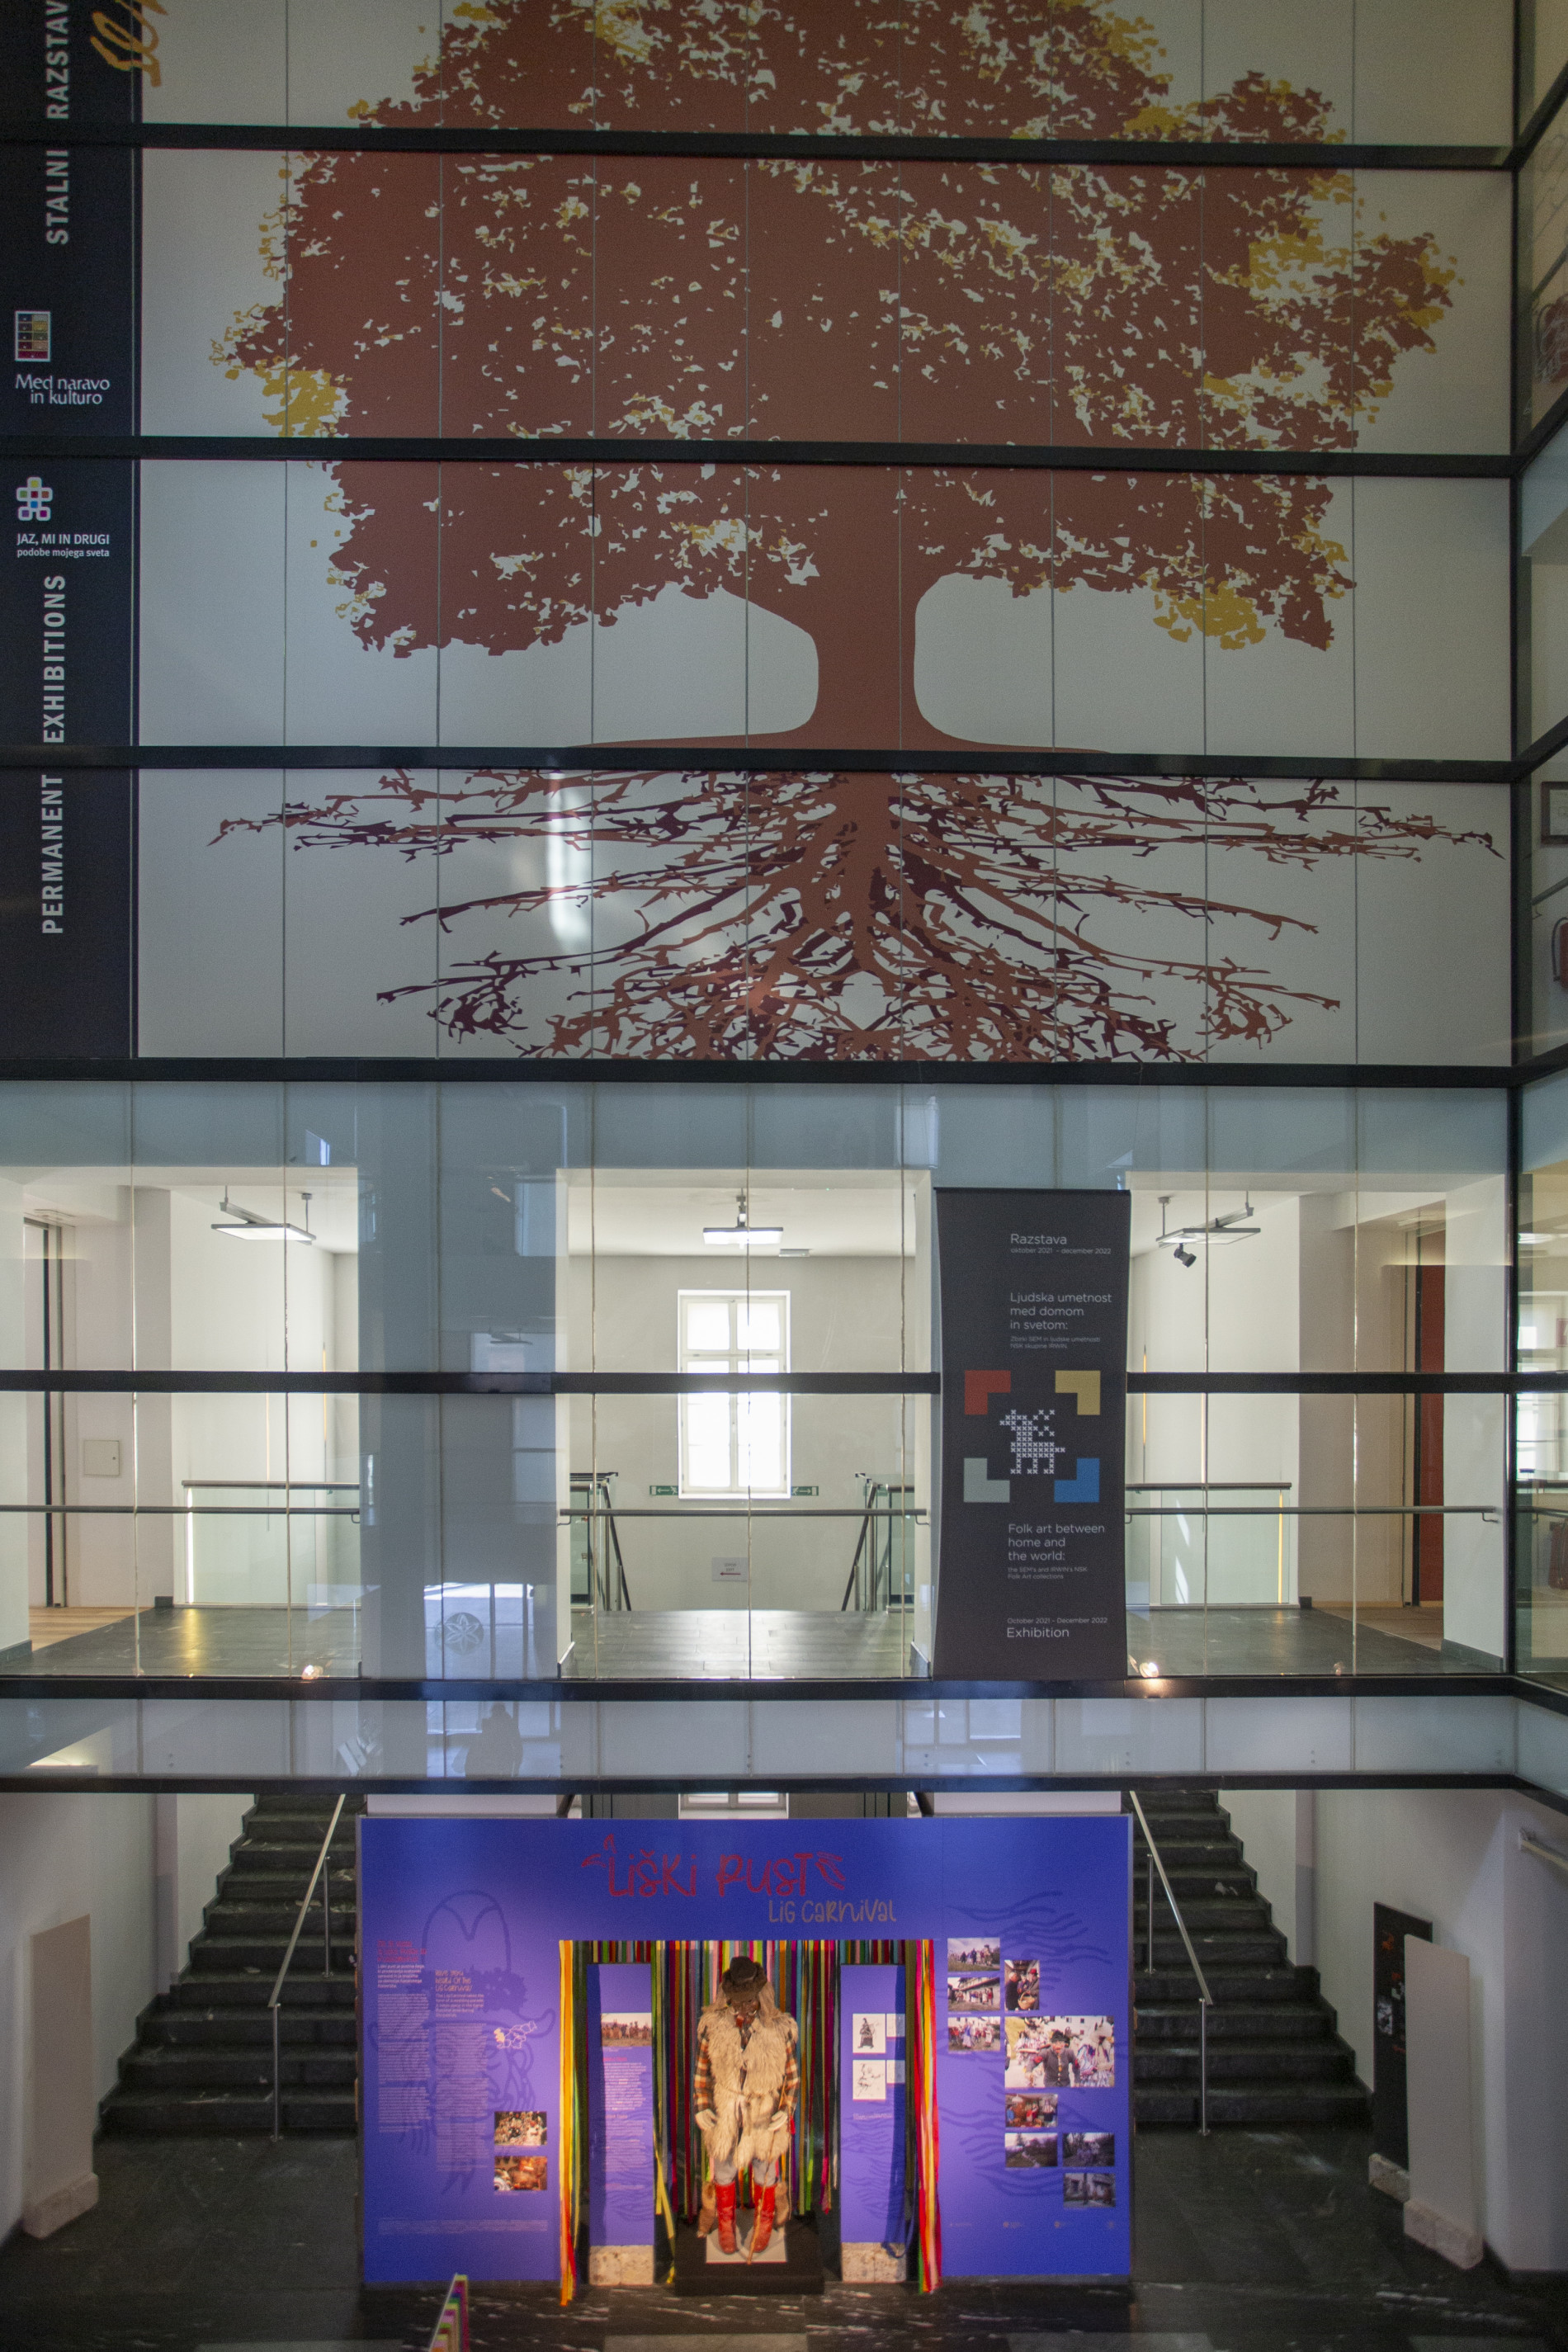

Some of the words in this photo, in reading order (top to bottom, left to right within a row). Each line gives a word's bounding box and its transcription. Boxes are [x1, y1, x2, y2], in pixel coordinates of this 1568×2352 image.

[45, 149, 70, 246] STALNI
[15, 374, 54, 390] Med
[57, 377, 111, 390] naravo
[30, 389, 44, 404] in
[49, 388, 103, 404] kulturo
[17, 533, 39, 546] JAZ,
[41, 533, 56, 545] MI
[59, 533, 71, 545] IN
[73, 534, 110, 545] DRUGI
[17, 548, 50, 558] podobe
[52, 548, 84, 559] mojega
[86, 550, 110, 558] sveta
[43, 574, 66, 744] EXHIBITIONS
[40, 774, 64, 934] PERMANENT
[1010, 1233, 1067, 1245] Razstava
[1010, 1292, 1055, 1304] Ljudska
[1057, 1293, 1112, 1303] umetnost
[1010, 1306, 1036, 1316] med
[1039, 1306, 1084, 1316] domom
[1010, 1320, 1020, 1329] in
[1023, 1320, 1068, 1330] svetom:
[1008, 1523, 1033, 1534] Folk
[1036, 1524, 1052, 1534] art
[1056, 1524, 1105, 1534] between
[1008, 1537, 1041, 1547] home
[1044, 1537, 1065, 1547] and
[1008, 1551, 1027, 1561] the
[1030, 1551, 1065, 1561] world:
[1007, 1627, 1070, 1638] Exhibition
[716, 1853, 814, 1897] PUST
